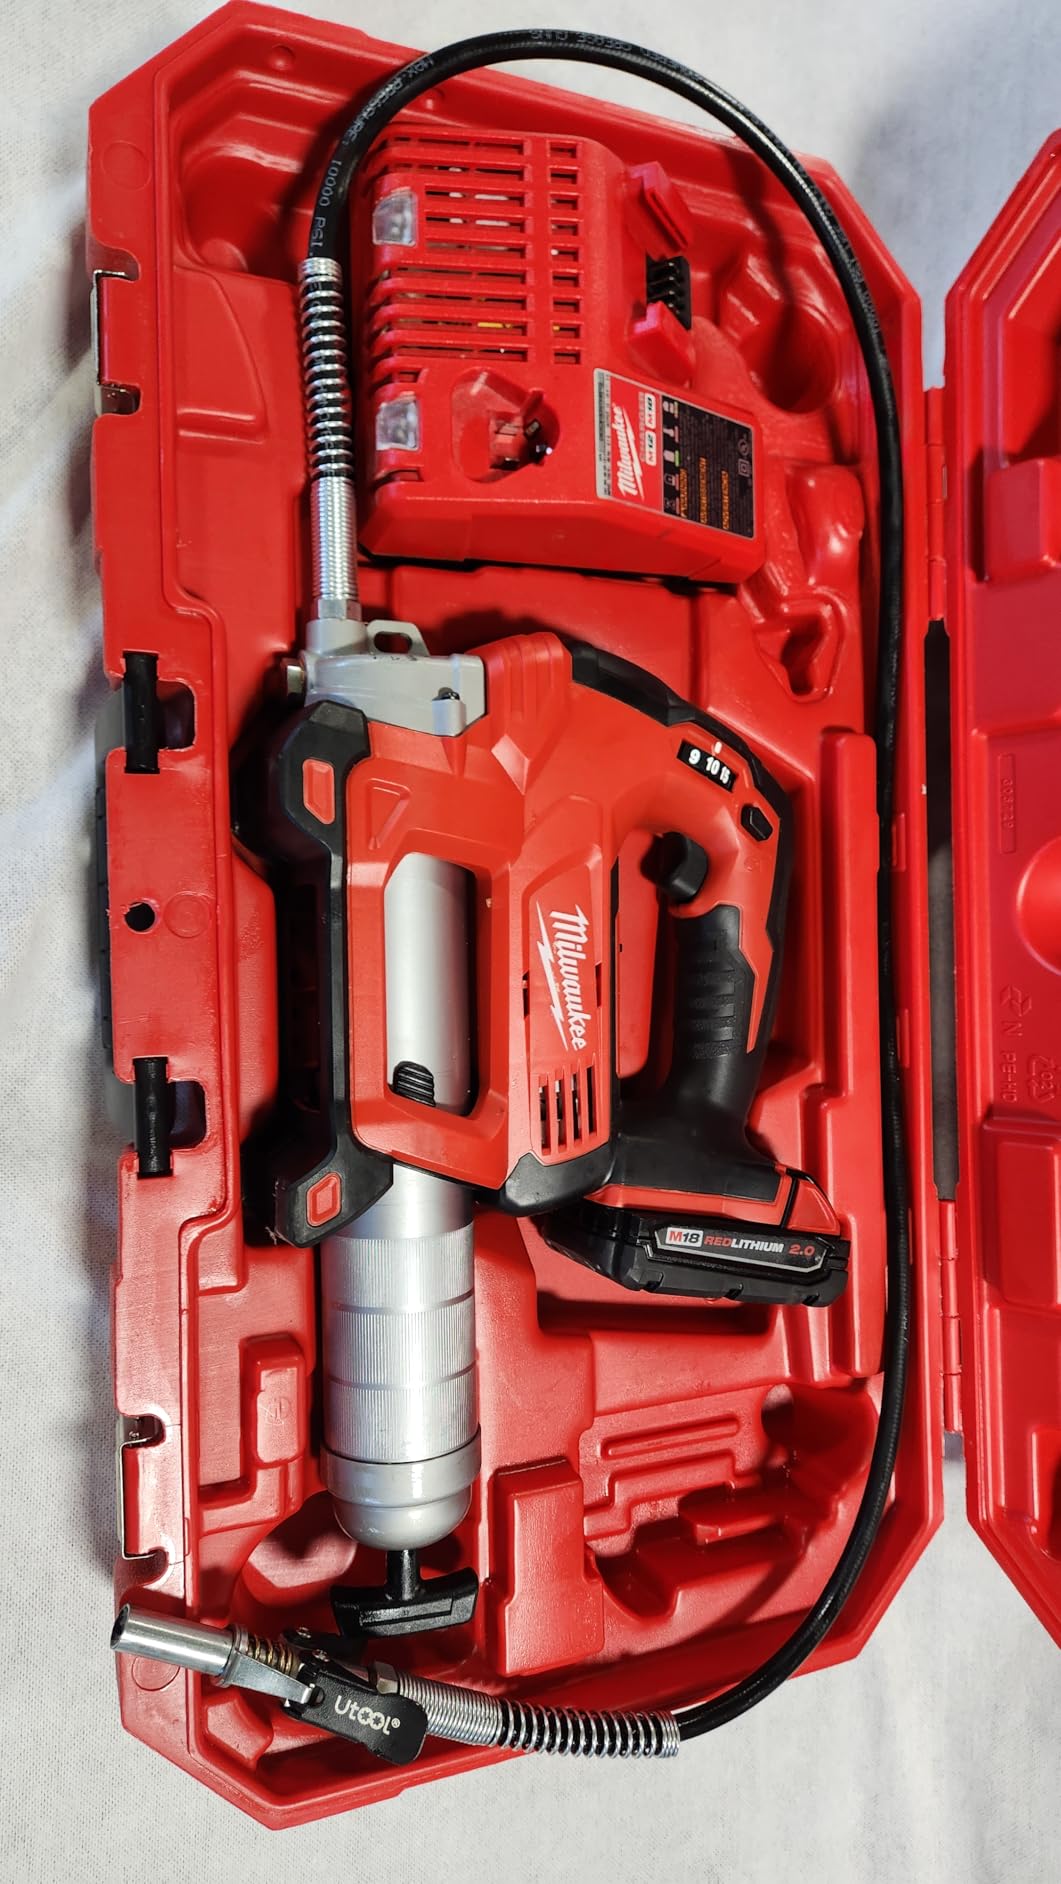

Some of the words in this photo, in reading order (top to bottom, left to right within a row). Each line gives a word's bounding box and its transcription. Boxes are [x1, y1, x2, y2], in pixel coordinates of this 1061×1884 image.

[318, 159, 342, 207] 10000
[612, 402, 639, 498] Milwaukee
[689, 749, 701, 765] 9
[706, 757, 720, 775] 10
[720, 766, 731, 784] 15
[549, 904, 592, 1051] Milwaukee
[668, 1231, 701, 1245] M18
[704, 1235, 785, 1253] REDLITHIUM
[788, 1244, 816, 1257] 2.0
